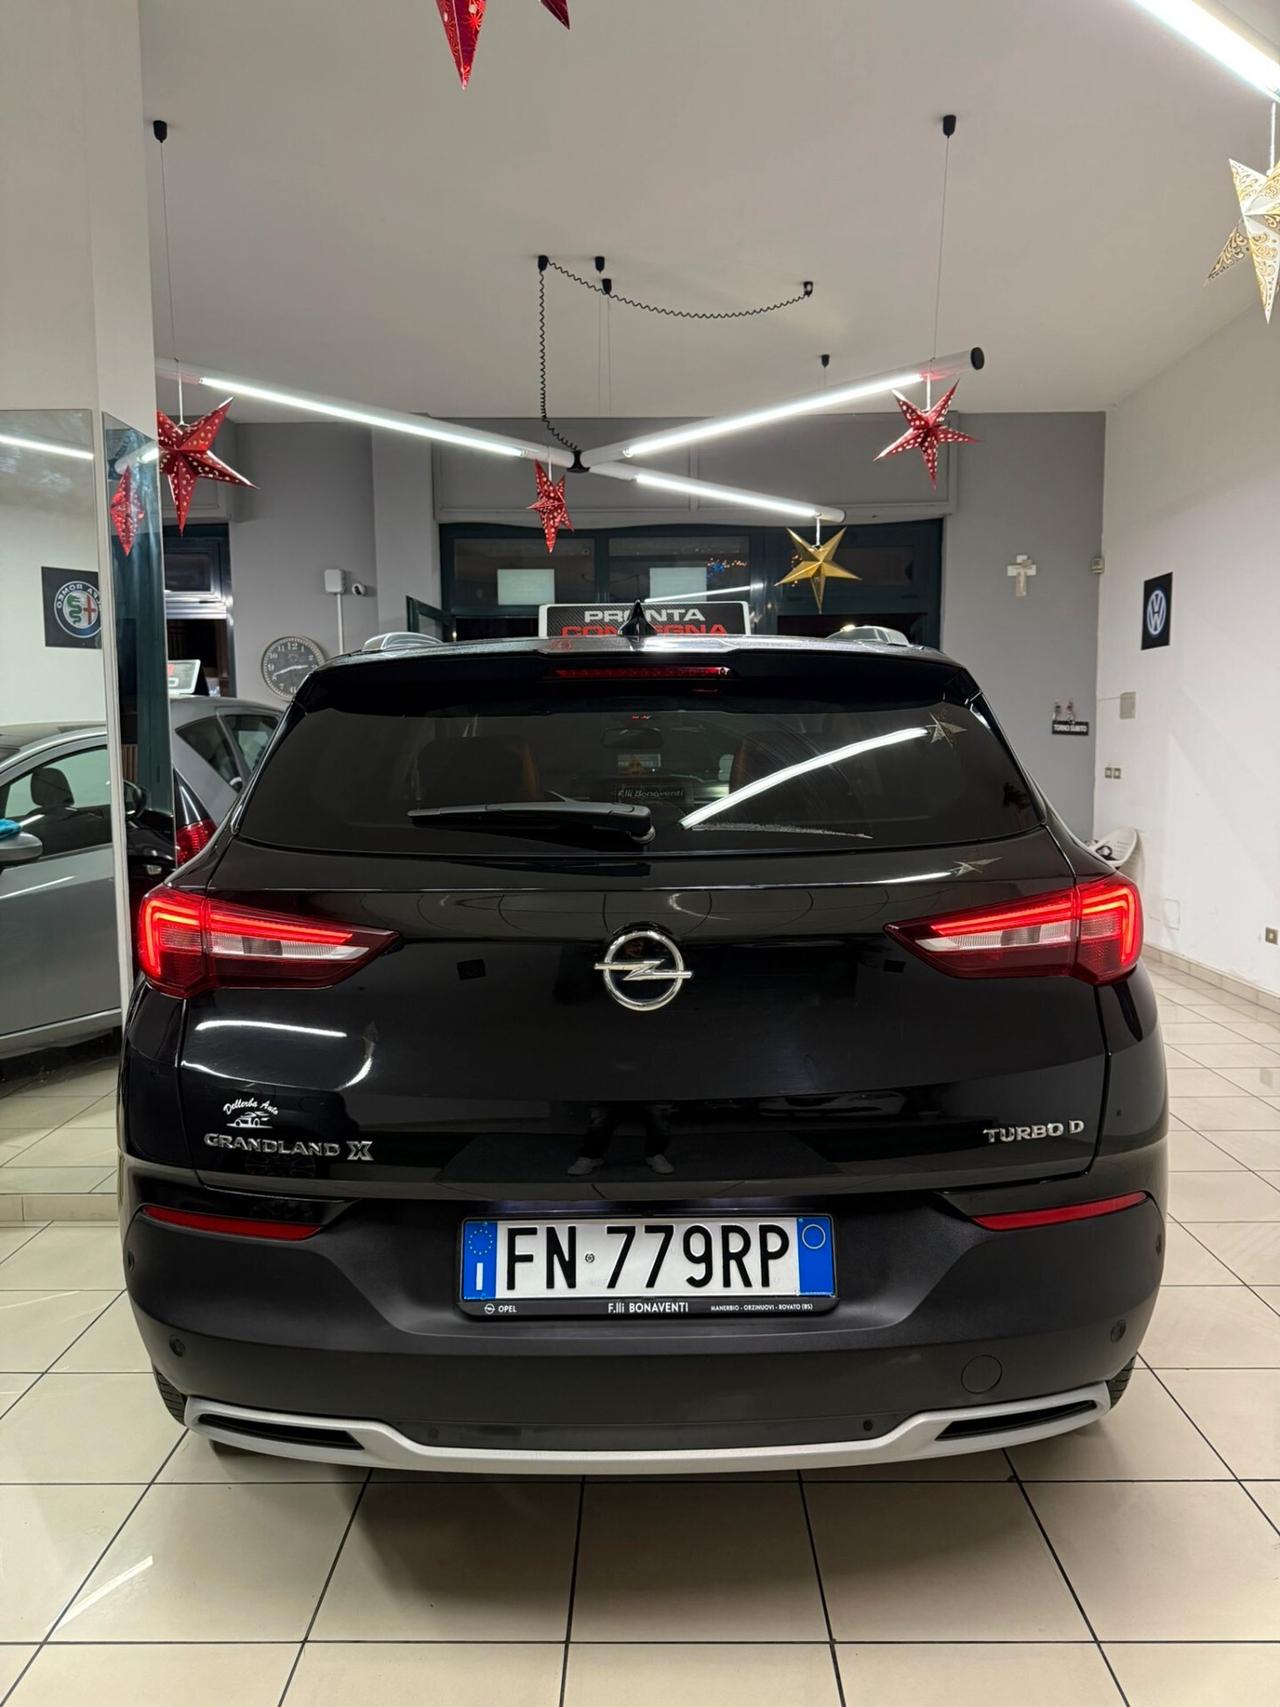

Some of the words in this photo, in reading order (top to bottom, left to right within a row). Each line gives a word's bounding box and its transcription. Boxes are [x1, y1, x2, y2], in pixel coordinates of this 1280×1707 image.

[584, 608, 706, 623] PRNTA
[260, 1100, 279, 1115] Auto
[983, 1122, 1064, 1143] TURBO
[1068, 1120, 1085, 1134] D
[203, 1133, 341, 1157] GRANDLAND
[346, 1140, 374, 1161] X
[475, 1262, 484, 1291] I
[498, 1305, 517, 1313] OPEL
[629, 1302, 689, 1313] BONAVENTI
[710, 1304, 740, 1312] MANERBIO
